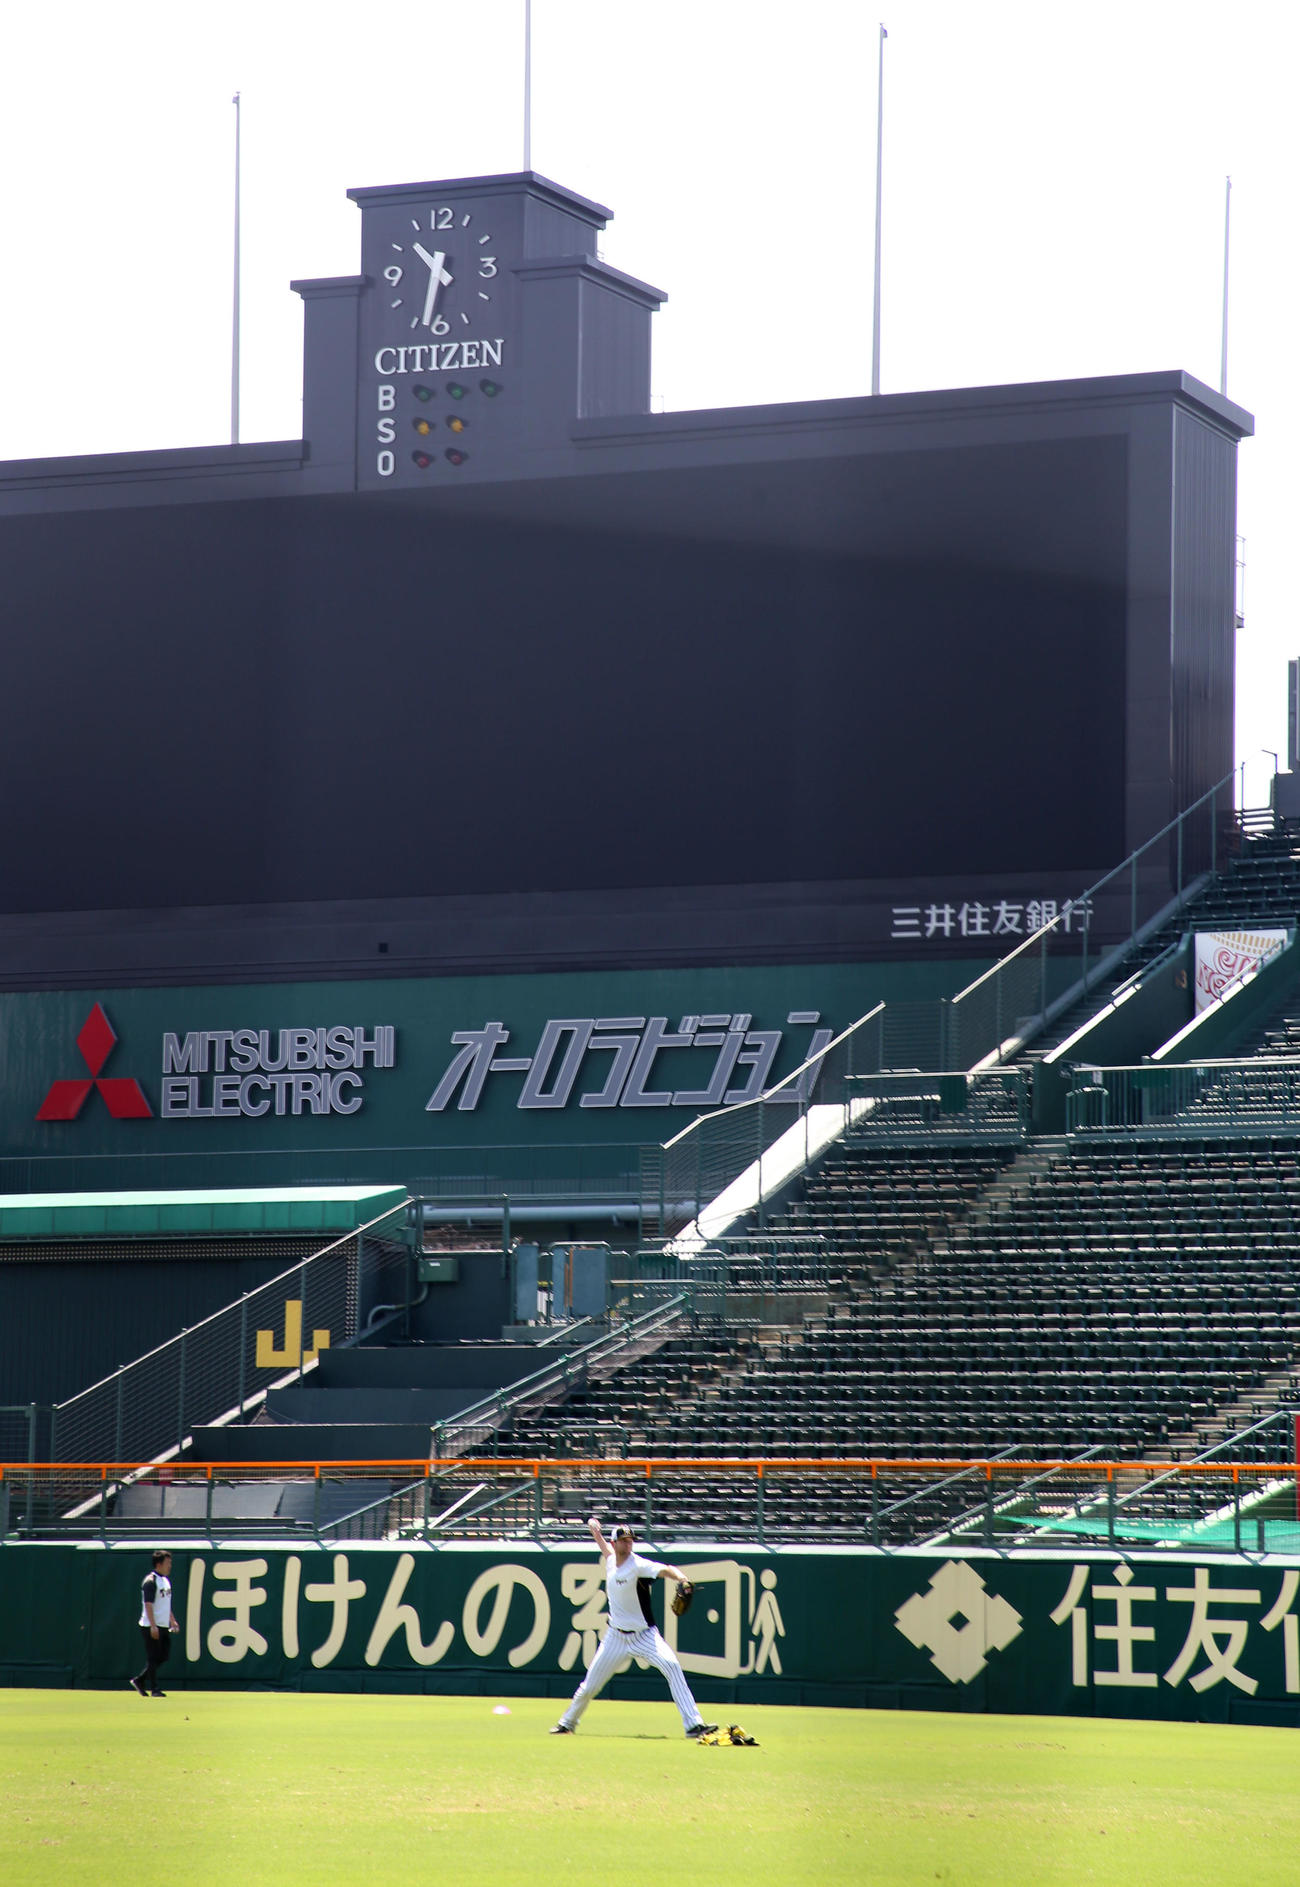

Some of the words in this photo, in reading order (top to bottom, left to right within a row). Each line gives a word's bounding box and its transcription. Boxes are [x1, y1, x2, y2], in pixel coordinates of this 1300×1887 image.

[430, 207, 454, 230] 12
[383, 265, 403, 287] 9
[478, 256, 498, 279] 3
[430, 313, 450, 335] 6
[374, 338, 505, 376] CITIZEN
[377, 384, 397, 412] B
[376, 418, 396, 444] S
[891, 898, 1094, 939] 三井住友銀行
[161, 1025, 395, 1073] MITSUBISHI
[160, 1072, 363, 1118] ELECTRIC
